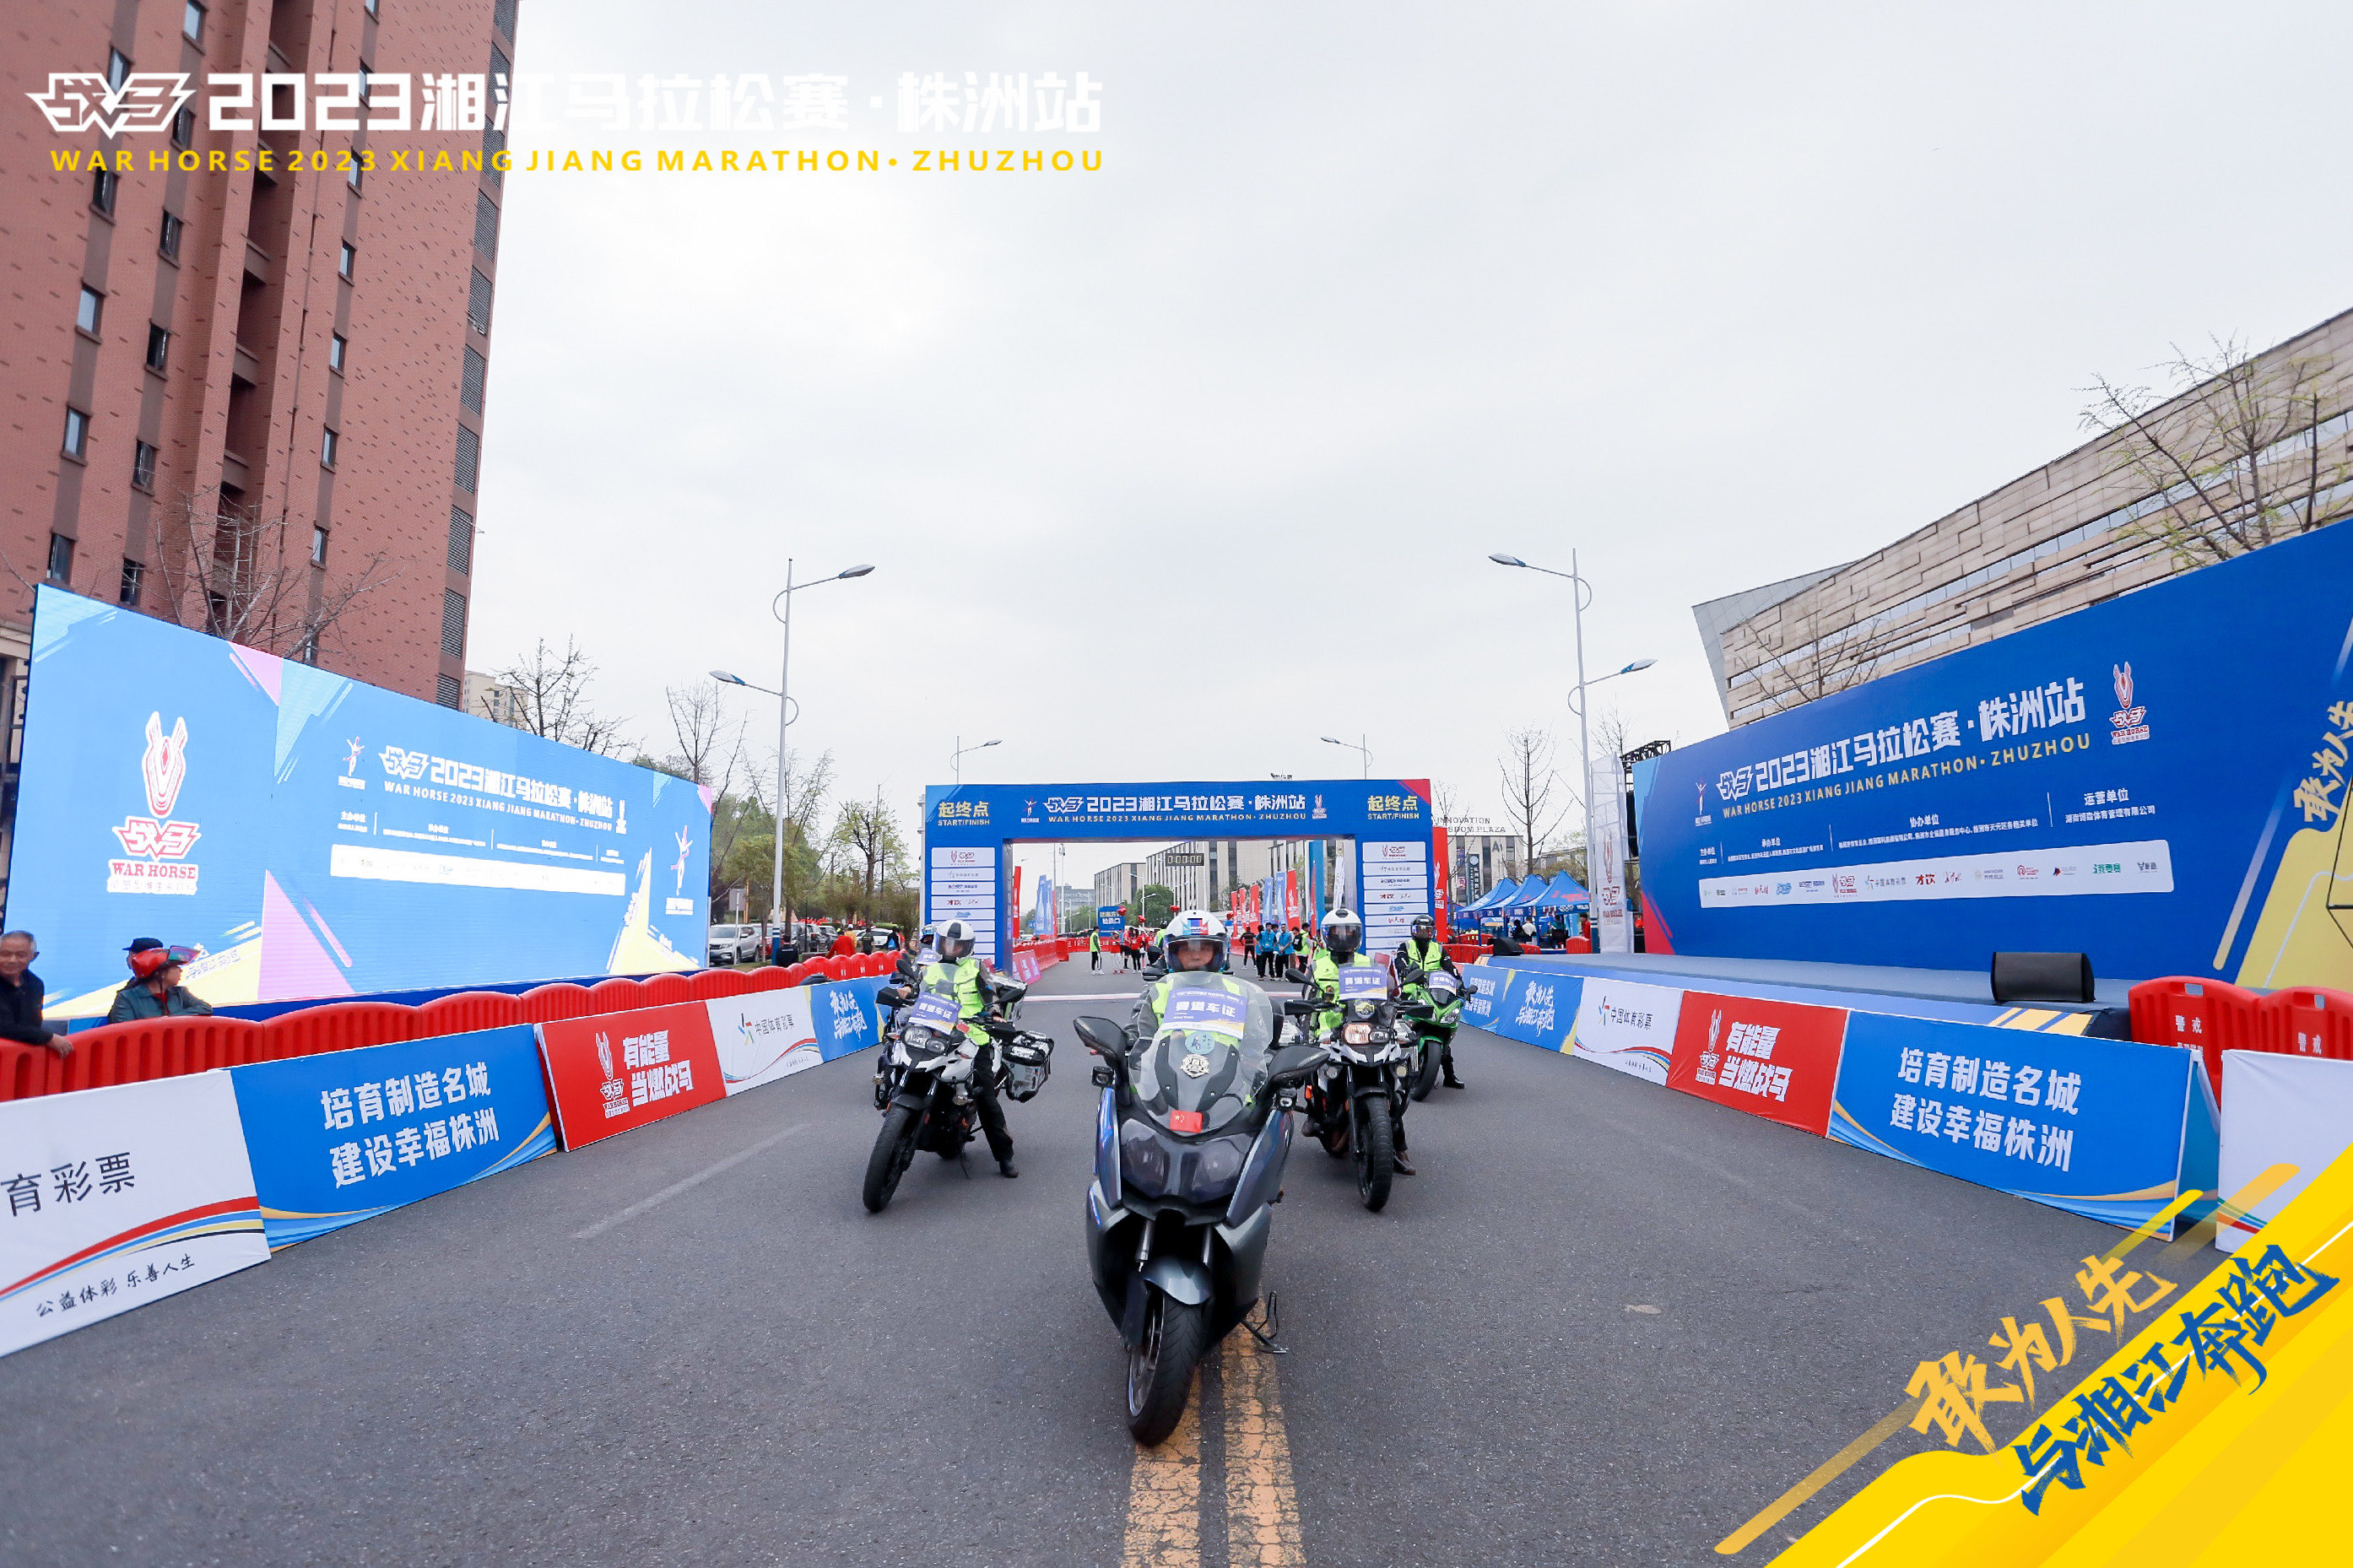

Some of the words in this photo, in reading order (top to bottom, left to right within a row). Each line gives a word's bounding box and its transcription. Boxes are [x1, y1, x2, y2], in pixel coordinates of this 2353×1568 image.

[384, 781, 410, 795] WAR
[413, 786, 448, 802] HORSE
[450, 793, 473, 807] 2023
[475, 798, 505, 811] XIANG
[506, 803, 532, 817] JIANG
[1723, 805, 1742, 819] WAR
[1744, 798, 1776, 814] HORSE
[1777, 792, 1802, 808] 2023
[1804, 784, 1842, 802] XIANG
[1845, 775, 1884, 794] JIANG
[1991, 733, 2091, 766] ZHUZHOU
[2084, 788, 2129, 806] 运营单位
[938, 801, 989, 818] 起终点
[1367, 796, 1418, 811] 起终点
[112, 862, 144, 876] WAR
[148, 864, 196, 879] HORSE
[1611, 1007, 1653, 1030] 中国体育彩票
[1726, 1022, 1782, 1060] 有能量
[623, 1030, 669, 1070] 有能量
[321, 1062, 492, 1130] 培育制造名城
[631, 1060, 694, 1107] 当燃战马
[1718, 1055, 1793, 1102] 当燃战马
[1897, 1047, 2082, 1116] 培育制造名城
[329, 1107, 500, 1189] 建设幸福株洲
[1890, 1093, 2074, 1172] 建设幸福株洲
[1, 1151, 136, 1218] 育彩票
[36, 1279, 118, 1317] 公益体彩
[127, 1253, 195, 1289] 乐善人生
